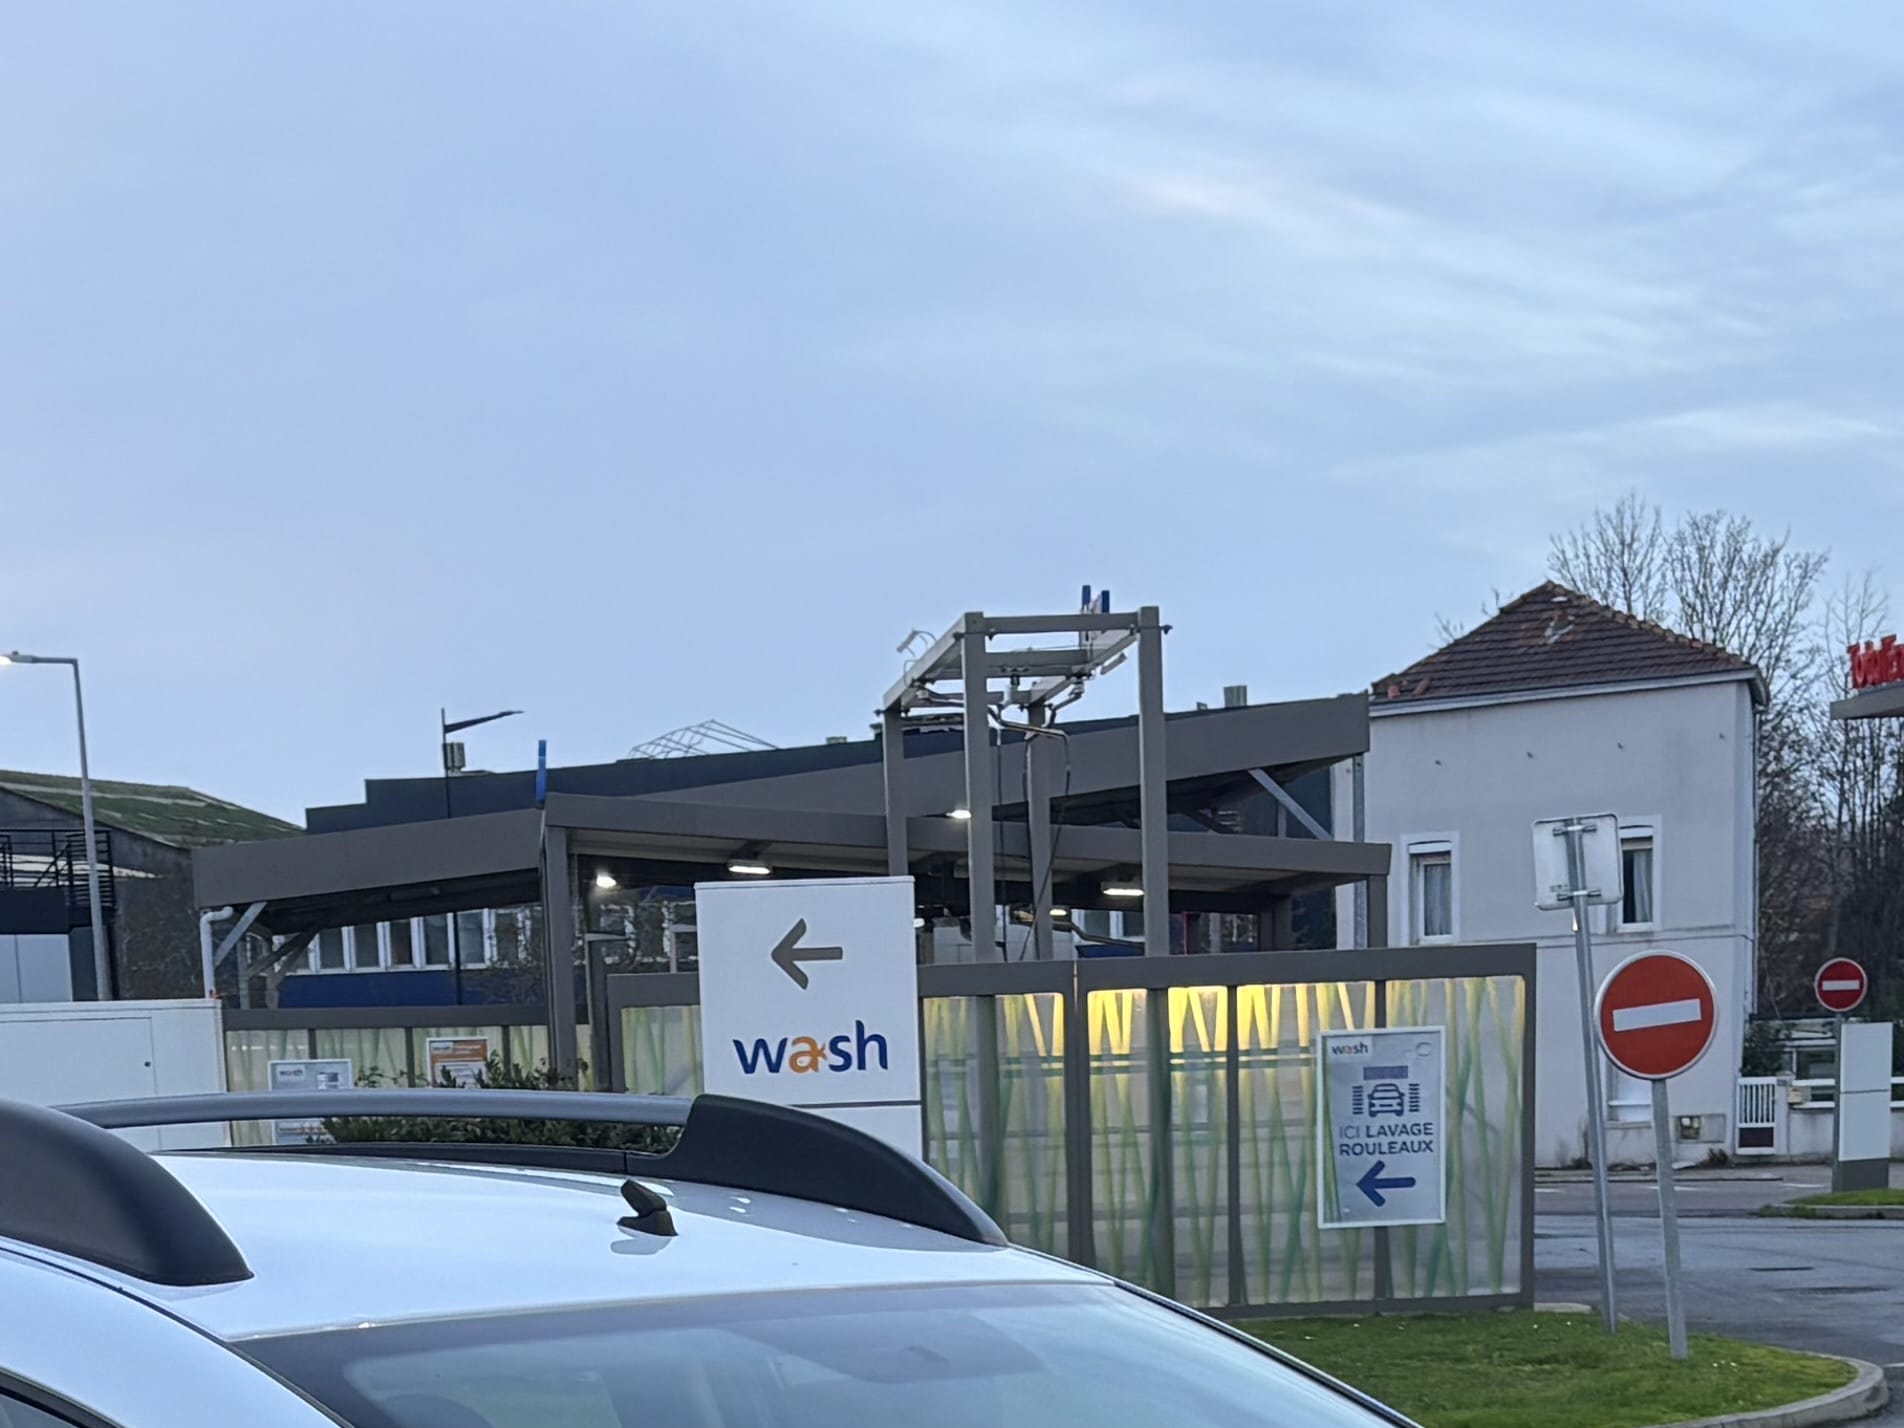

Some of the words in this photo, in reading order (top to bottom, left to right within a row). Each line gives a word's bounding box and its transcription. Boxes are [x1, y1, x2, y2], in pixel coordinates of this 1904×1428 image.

[733, 1020, 889, 1074] wash
[1331, 1041, 1369, 1056] wash
[1339, 1125, 1361, 1139] ICI
[1365, 1122, 1434, 1139] LAVAGE
[1339, 1140, 1434, 1156] ROULEAUX
